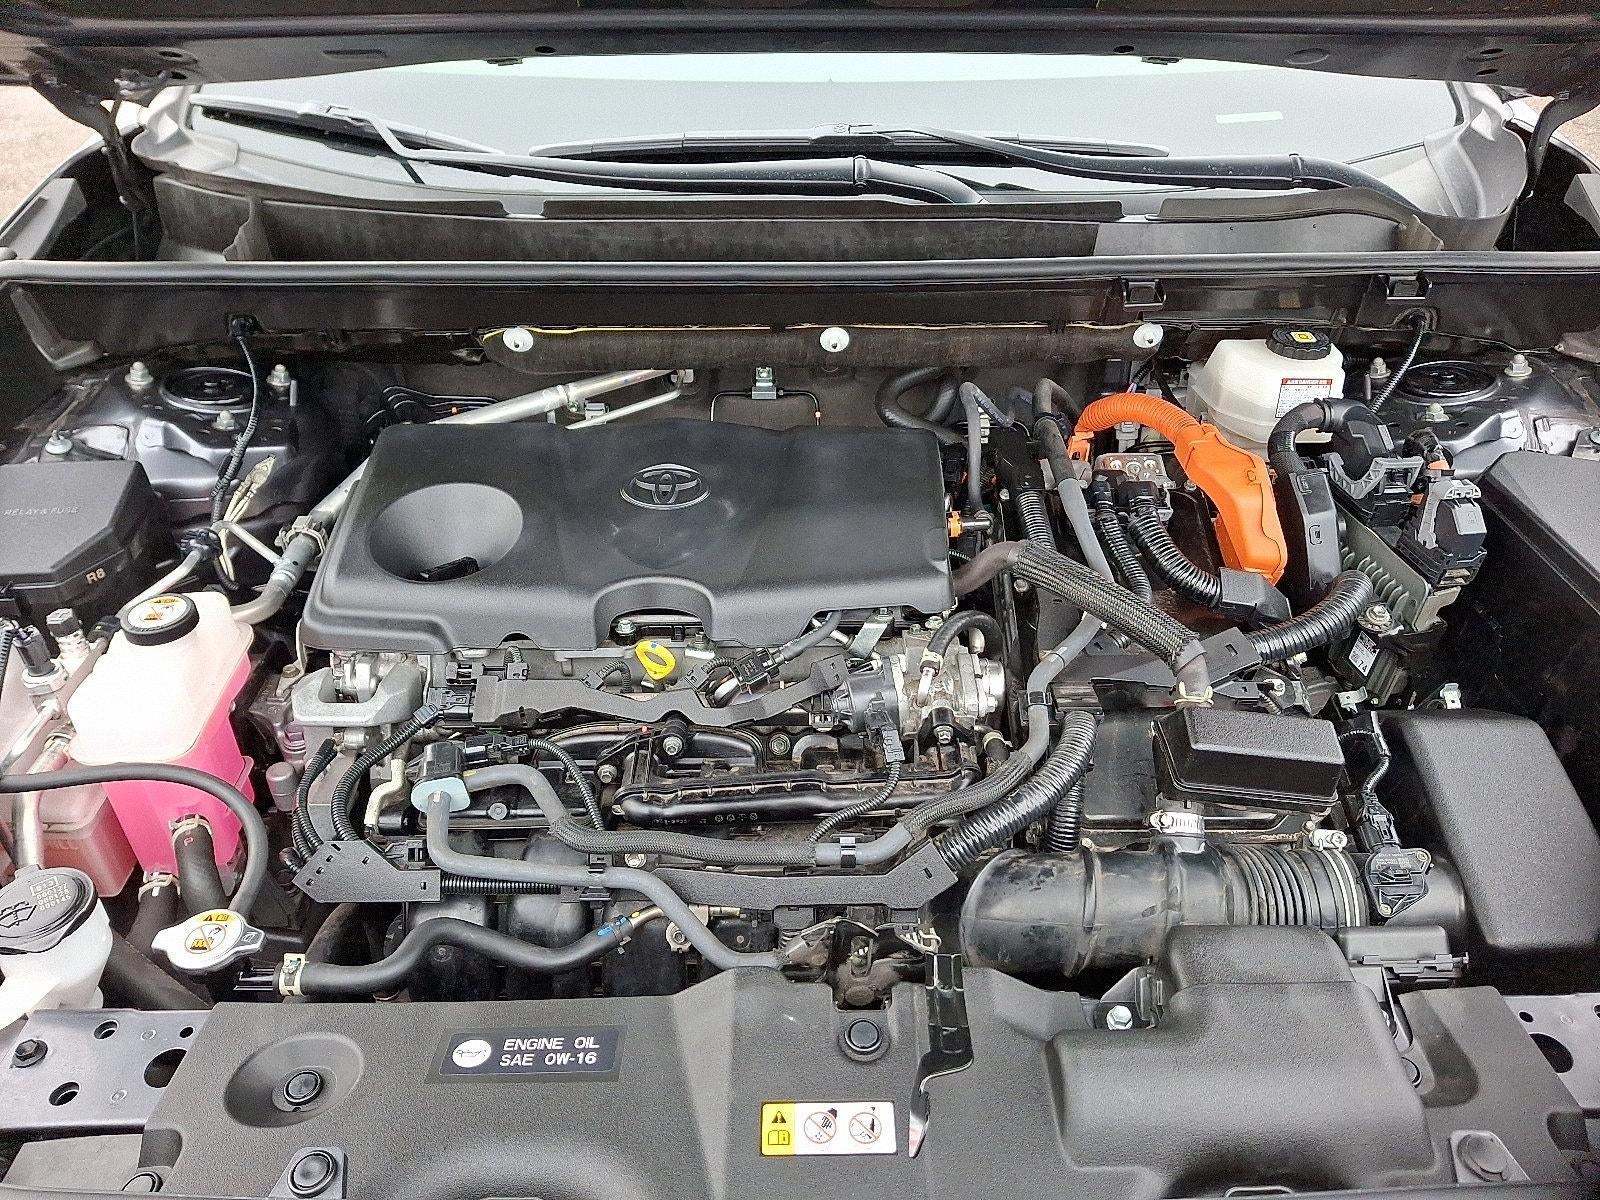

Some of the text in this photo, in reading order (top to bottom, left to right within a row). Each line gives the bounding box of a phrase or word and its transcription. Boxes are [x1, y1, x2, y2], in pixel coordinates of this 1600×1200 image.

[503, 1036, 600, 1051] ENGINE OIL
[499, 1051, 597, 1067] SAE 0W-16
